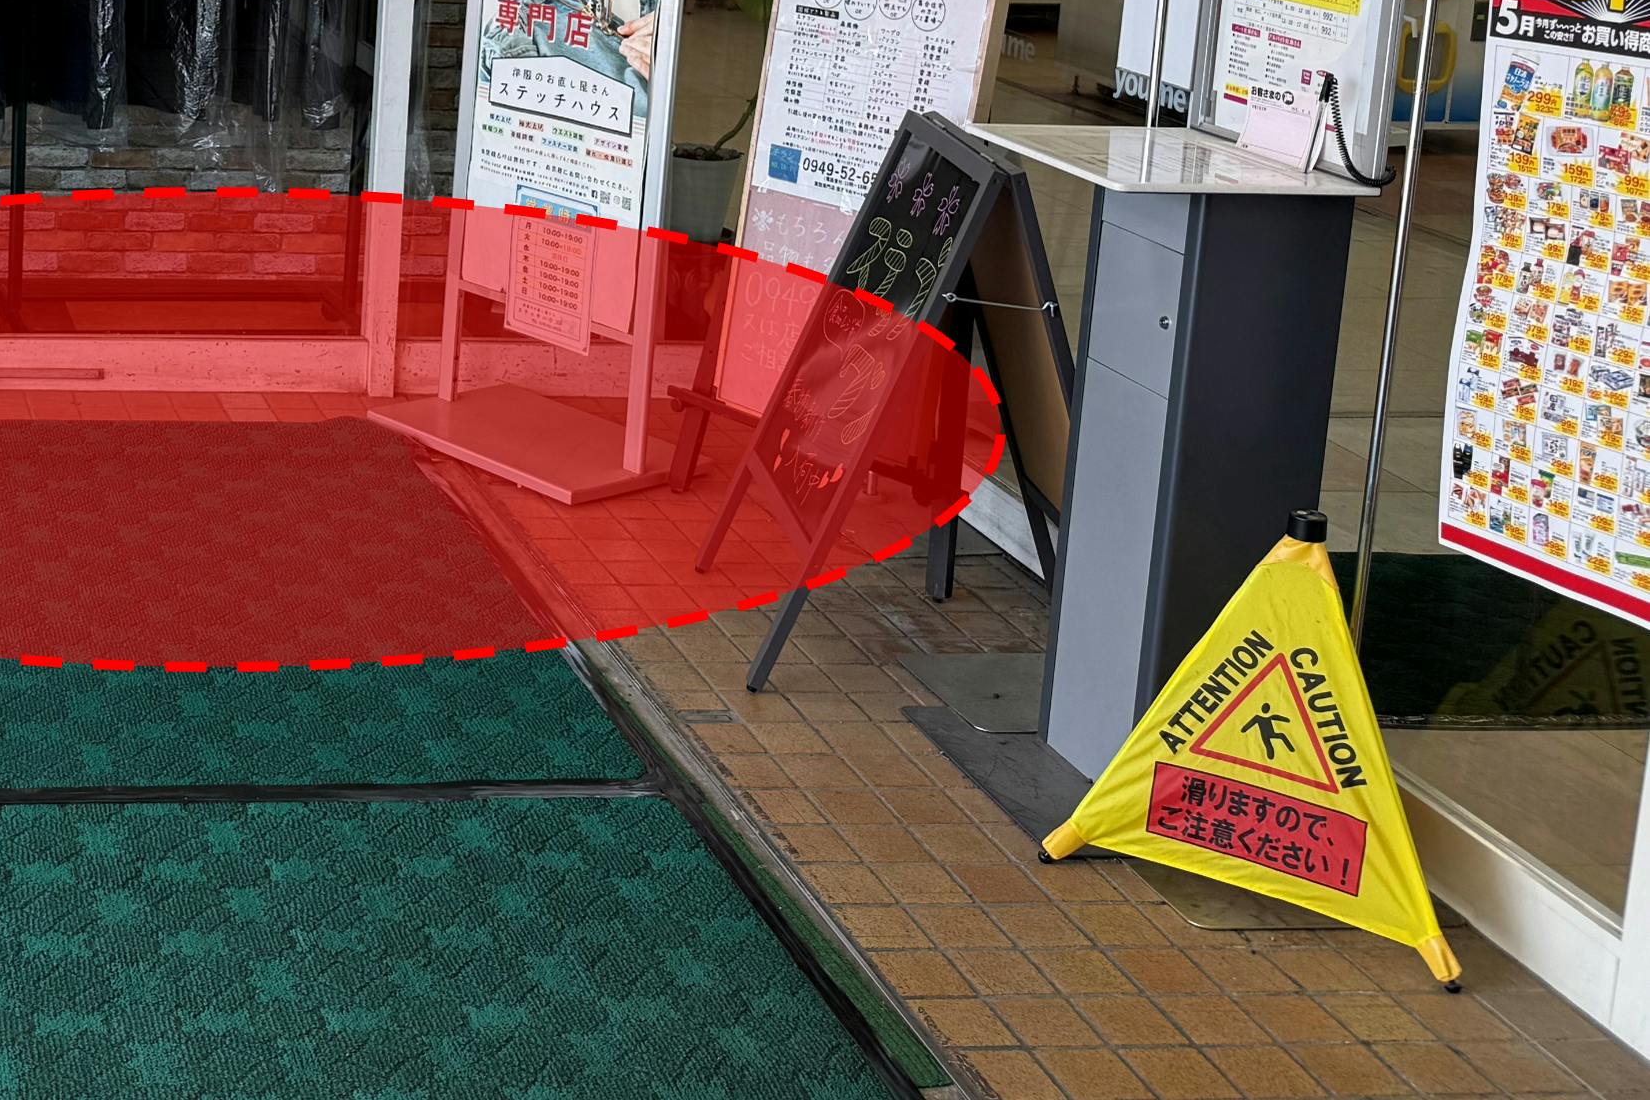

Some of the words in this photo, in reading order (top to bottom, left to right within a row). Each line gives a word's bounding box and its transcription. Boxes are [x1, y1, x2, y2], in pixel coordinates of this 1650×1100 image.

[1495, 0, 1535, 37] 5月
[499, 82, 620, 121] ステッチハウス
[512, 67, 609, 97] 洋服のお直し屋さん
[1251, 86, 1281, 100] お客さまの
[1157, 629, 1275, 756] ATTENTION
[1290, 646, 1368, 789] CAUTION
[1180, 775, 1335, 848] 滑りますので、
[1157, 804, 1350, 887] ご注意ください！
